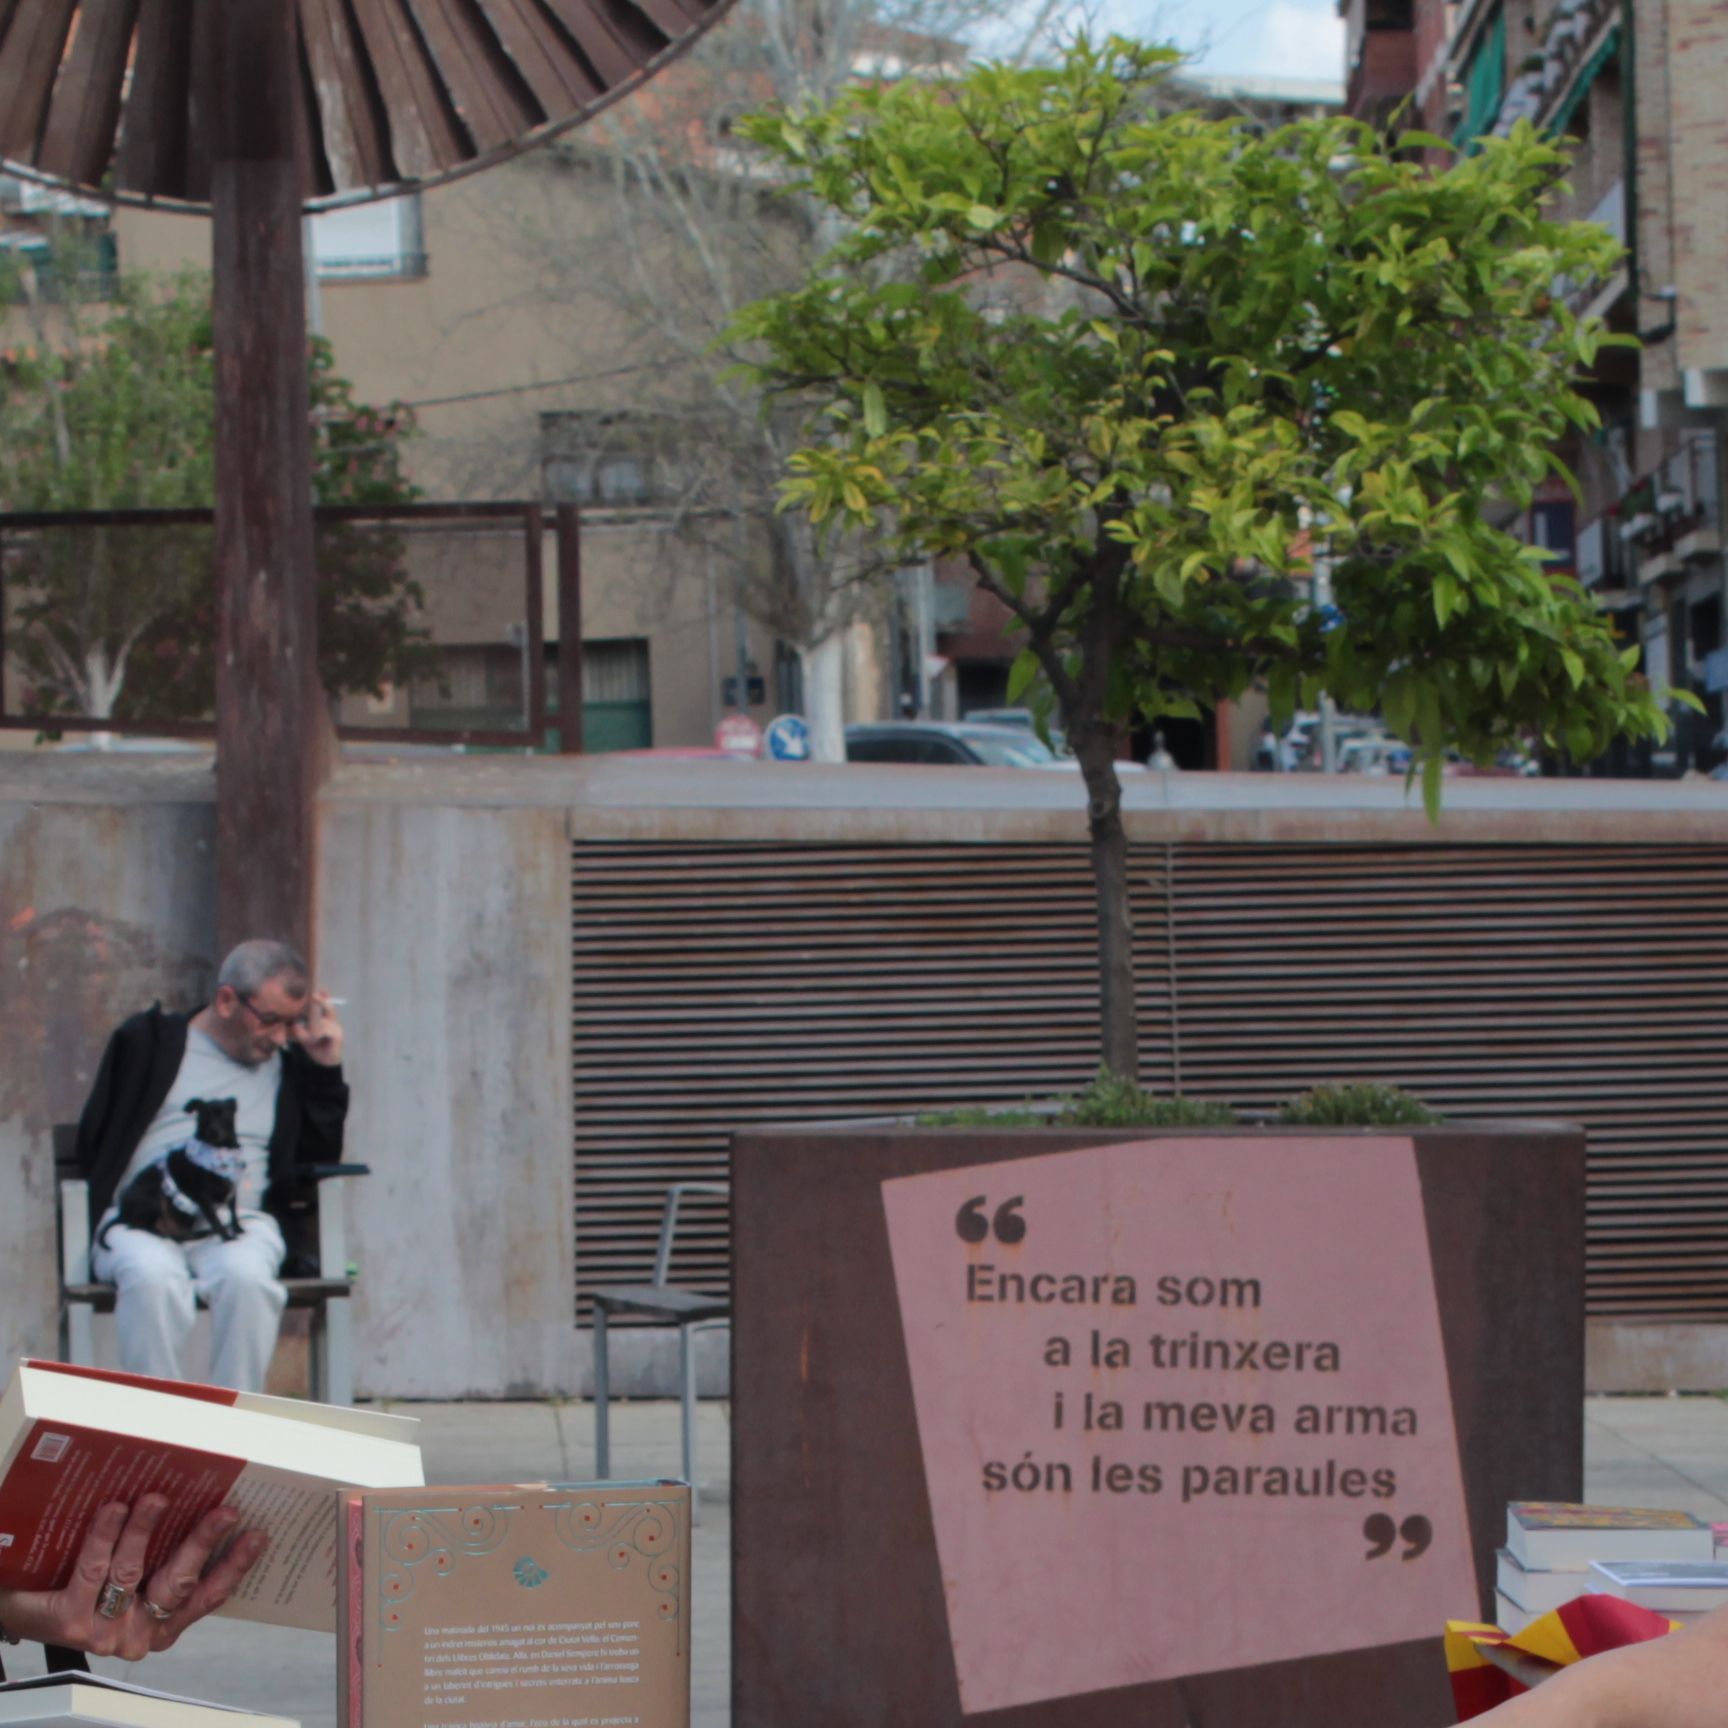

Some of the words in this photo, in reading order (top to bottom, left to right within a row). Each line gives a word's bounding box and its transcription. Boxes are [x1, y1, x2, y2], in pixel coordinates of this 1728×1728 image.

[965, 1264, 1138, 1307] Encara
[1155, 1275, 1263, 1308] som
[1042, 1335, 1072, 1369] a
[1089, 1330, 1132, 1370] la
[1149, 1331, 1341, 1373] trinxera
[1053, 1392, 1064, 1430] i
[1083, 1392, 1125, 1431] la
[1141, 1400, 1276, 1434] meva
[1293, 1402, 1418, 1437] arma
[981, 1452, 1073, 1493] són
[1091, 1455, 1163, 1494] les
[1181, 1458, 1397, 1503] paraules
